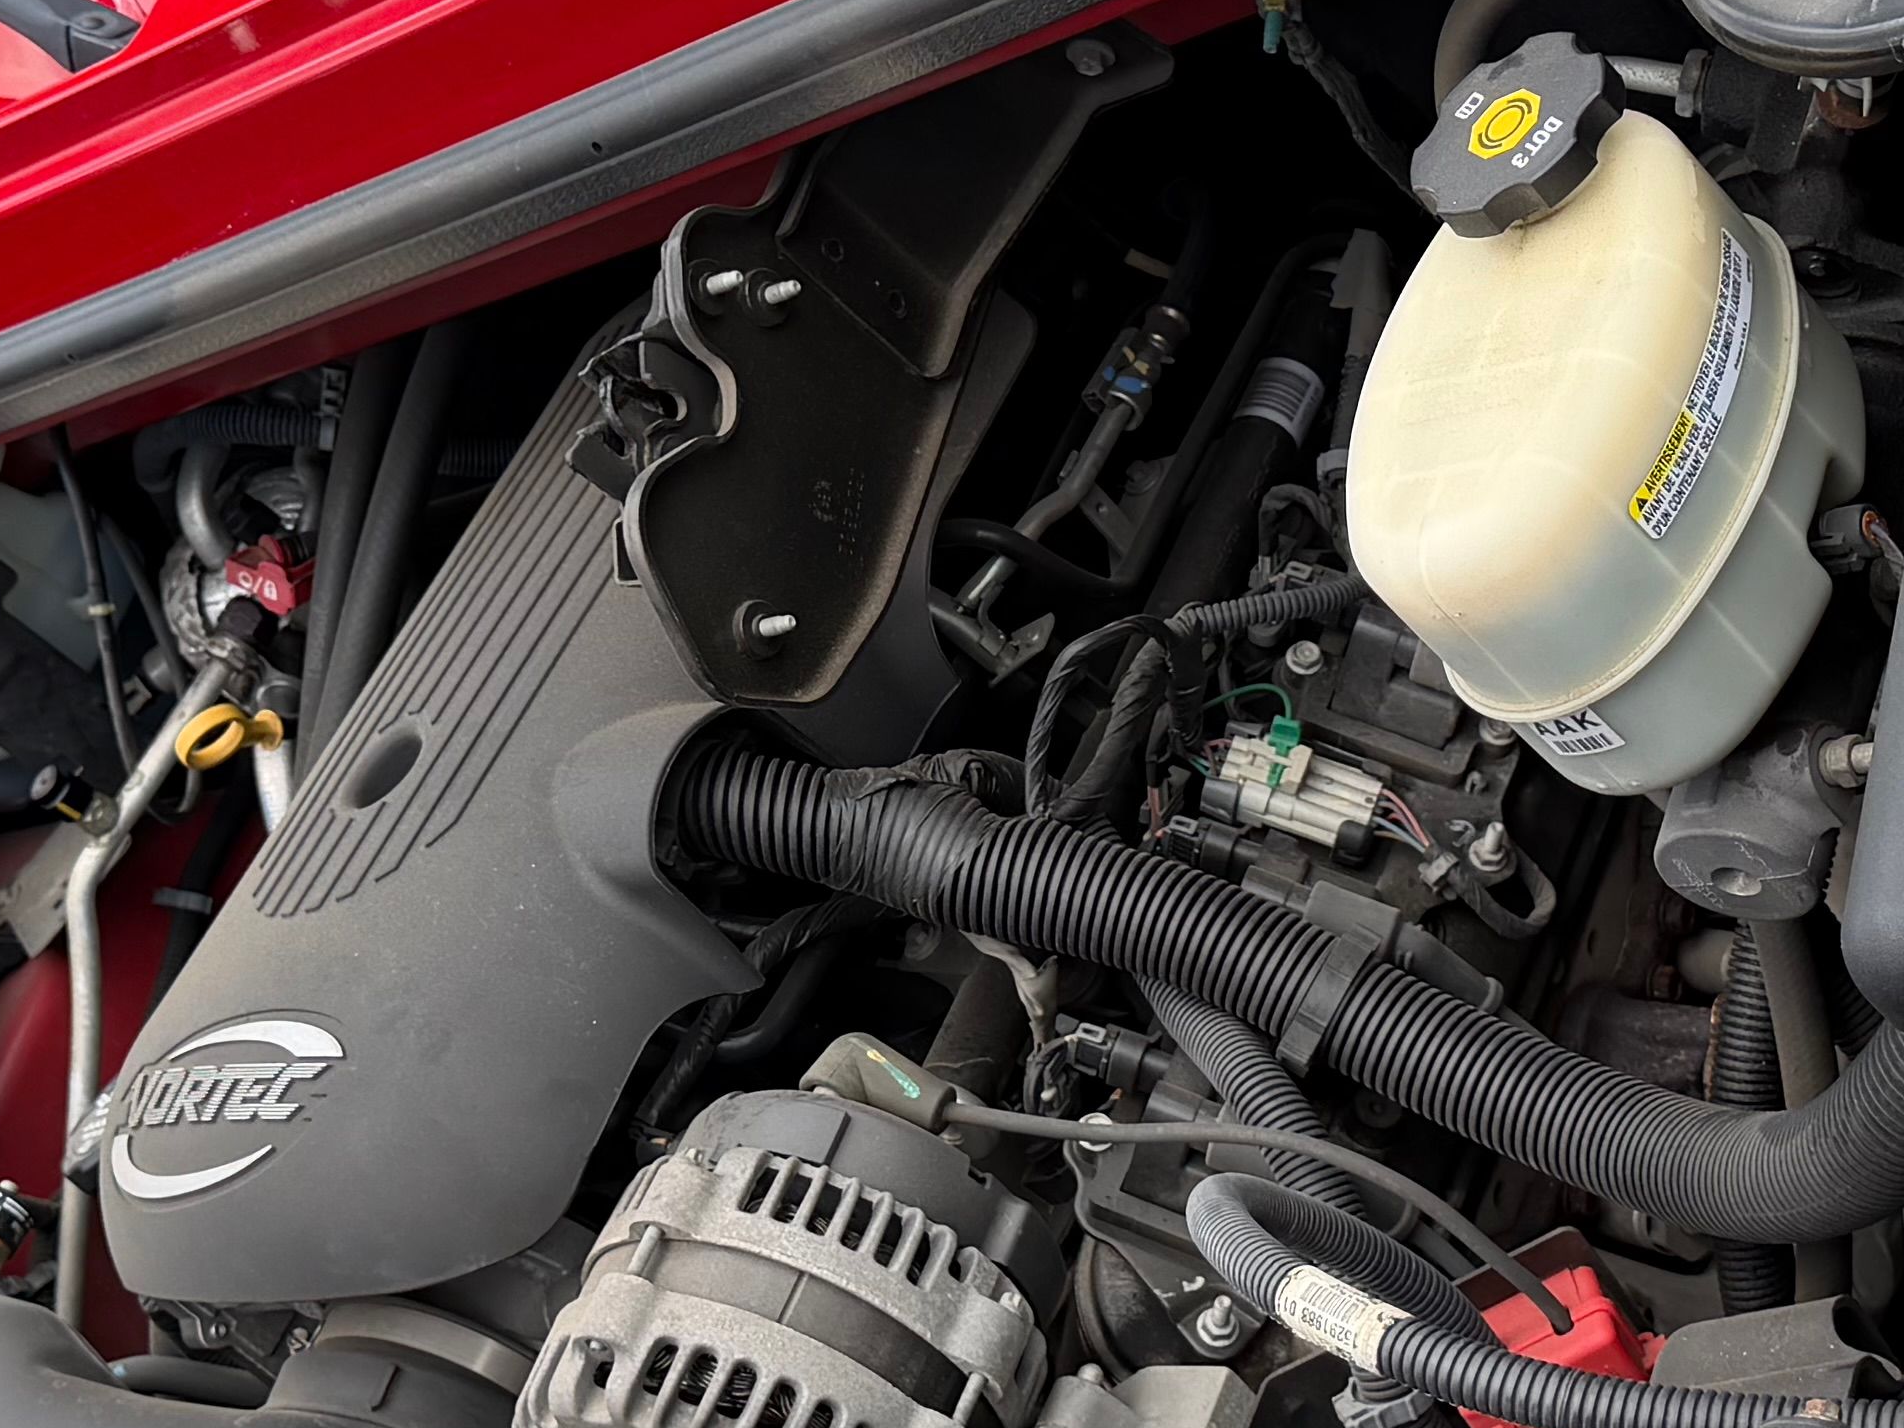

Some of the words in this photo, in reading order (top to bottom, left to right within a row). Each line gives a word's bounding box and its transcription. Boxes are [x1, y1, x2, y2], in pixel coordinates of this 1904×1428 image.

[1511, 153, 1529, 168] 3
[1525, 116, 1564, 156] DOT
[1642, 491, 1666, 525] AVANT
[1661, 476, 1675, 493] DE
[1670, 424, 1702, 476] L'ENLEVER
[1645, 412, 1690, 492] AVERTISSEMENT
[1652, 511, 1673, 536] D'UN
[1668, 451, 1704, 511] CONTENANT
[1533, 711, 1602, 736] AAK
[128, 1062, 328, 1130] VORTEC
